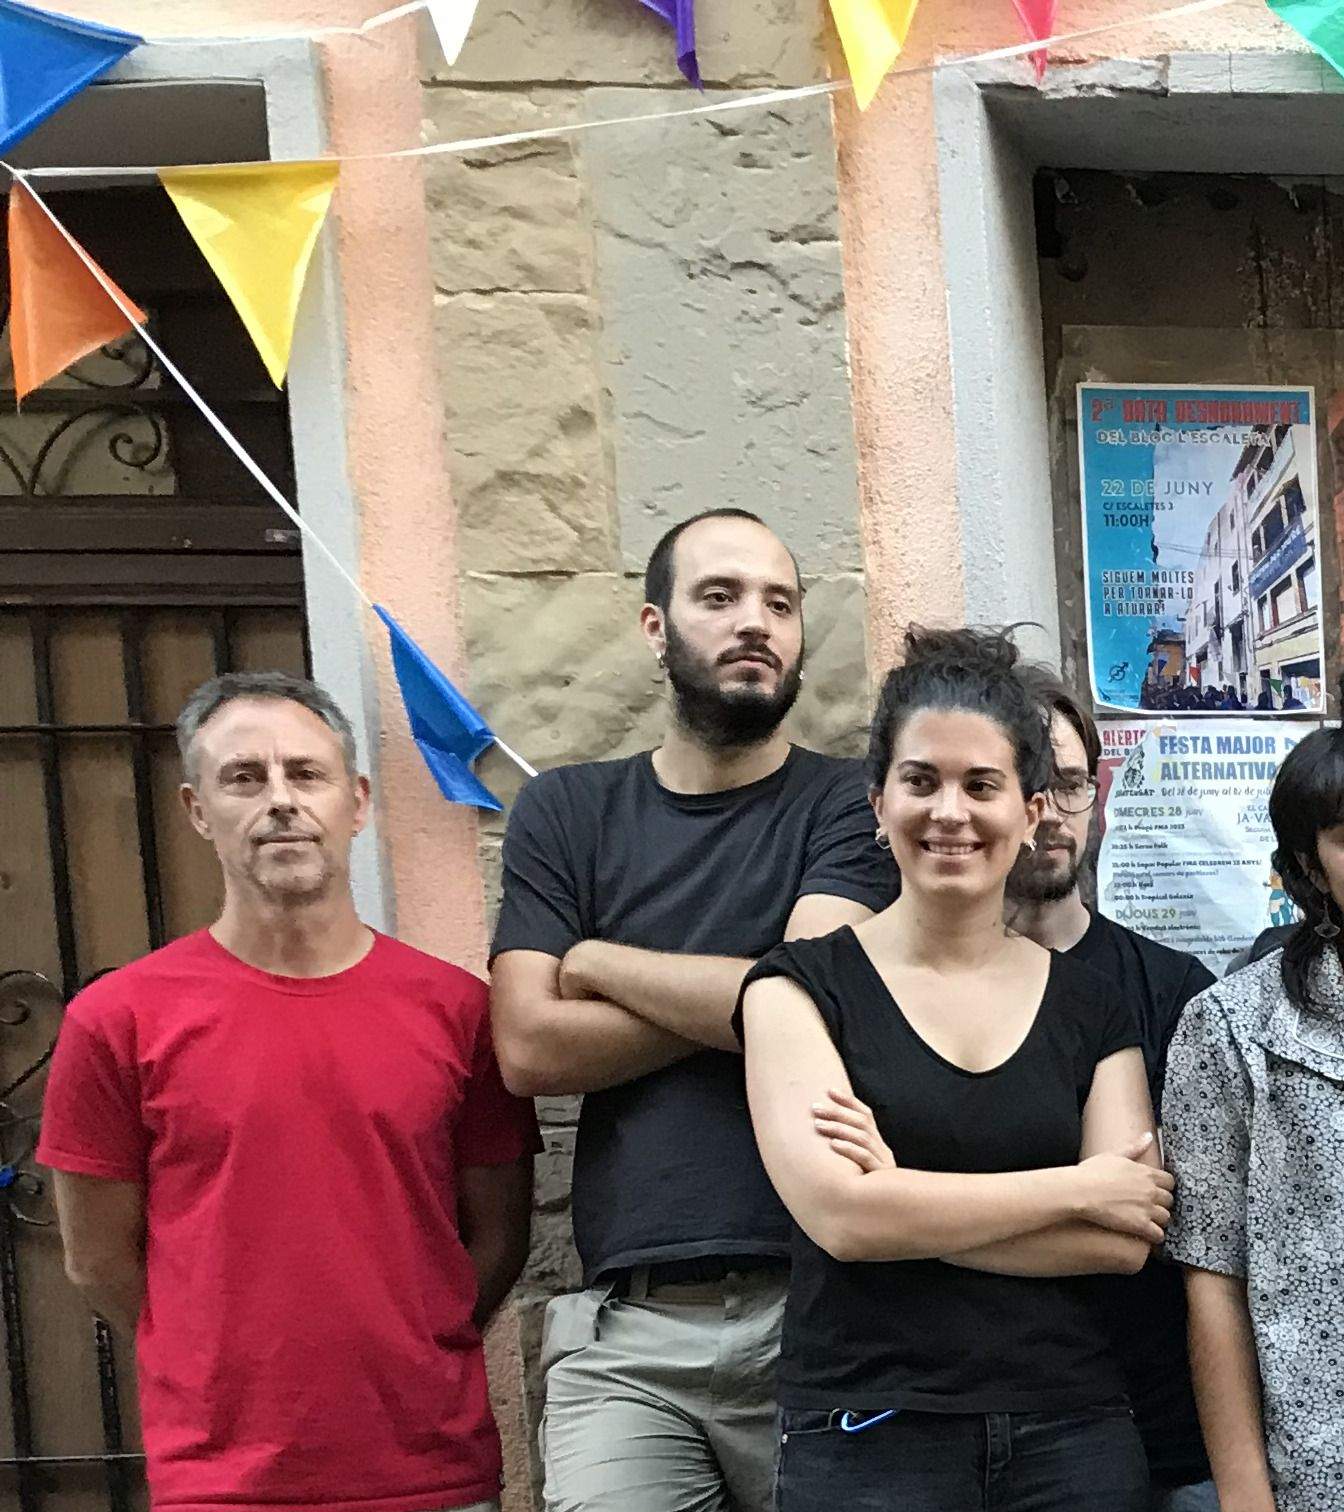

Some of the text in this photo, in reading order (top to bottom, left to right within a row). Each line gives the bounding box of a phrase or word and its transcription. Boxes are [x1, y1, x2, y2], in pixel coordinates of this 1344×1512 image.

[1097, 431, 1125, 443] DEL
[1131, 431, 1172, 444] BLOC
[1101, 480, 1214, 497] 22 DE JUNY
[1103, 571, 1194, 584] SIGUEM MOLTES
[1104, 587, 1124, 600] PER
[1104, 602, 1111, 615] A
[1160, 736, 1213, 755] FESTA
[1217, 736, 1276, 755] MAJOR
[1104, 748, 1122, 757] DEL
[1160, 761, 1278, 781] ALTERNATIVA
[1188, 786, 1198, 796] de
[1168, 806, 1182, 817] 28
[1162, 908, 1177, 919] 29
